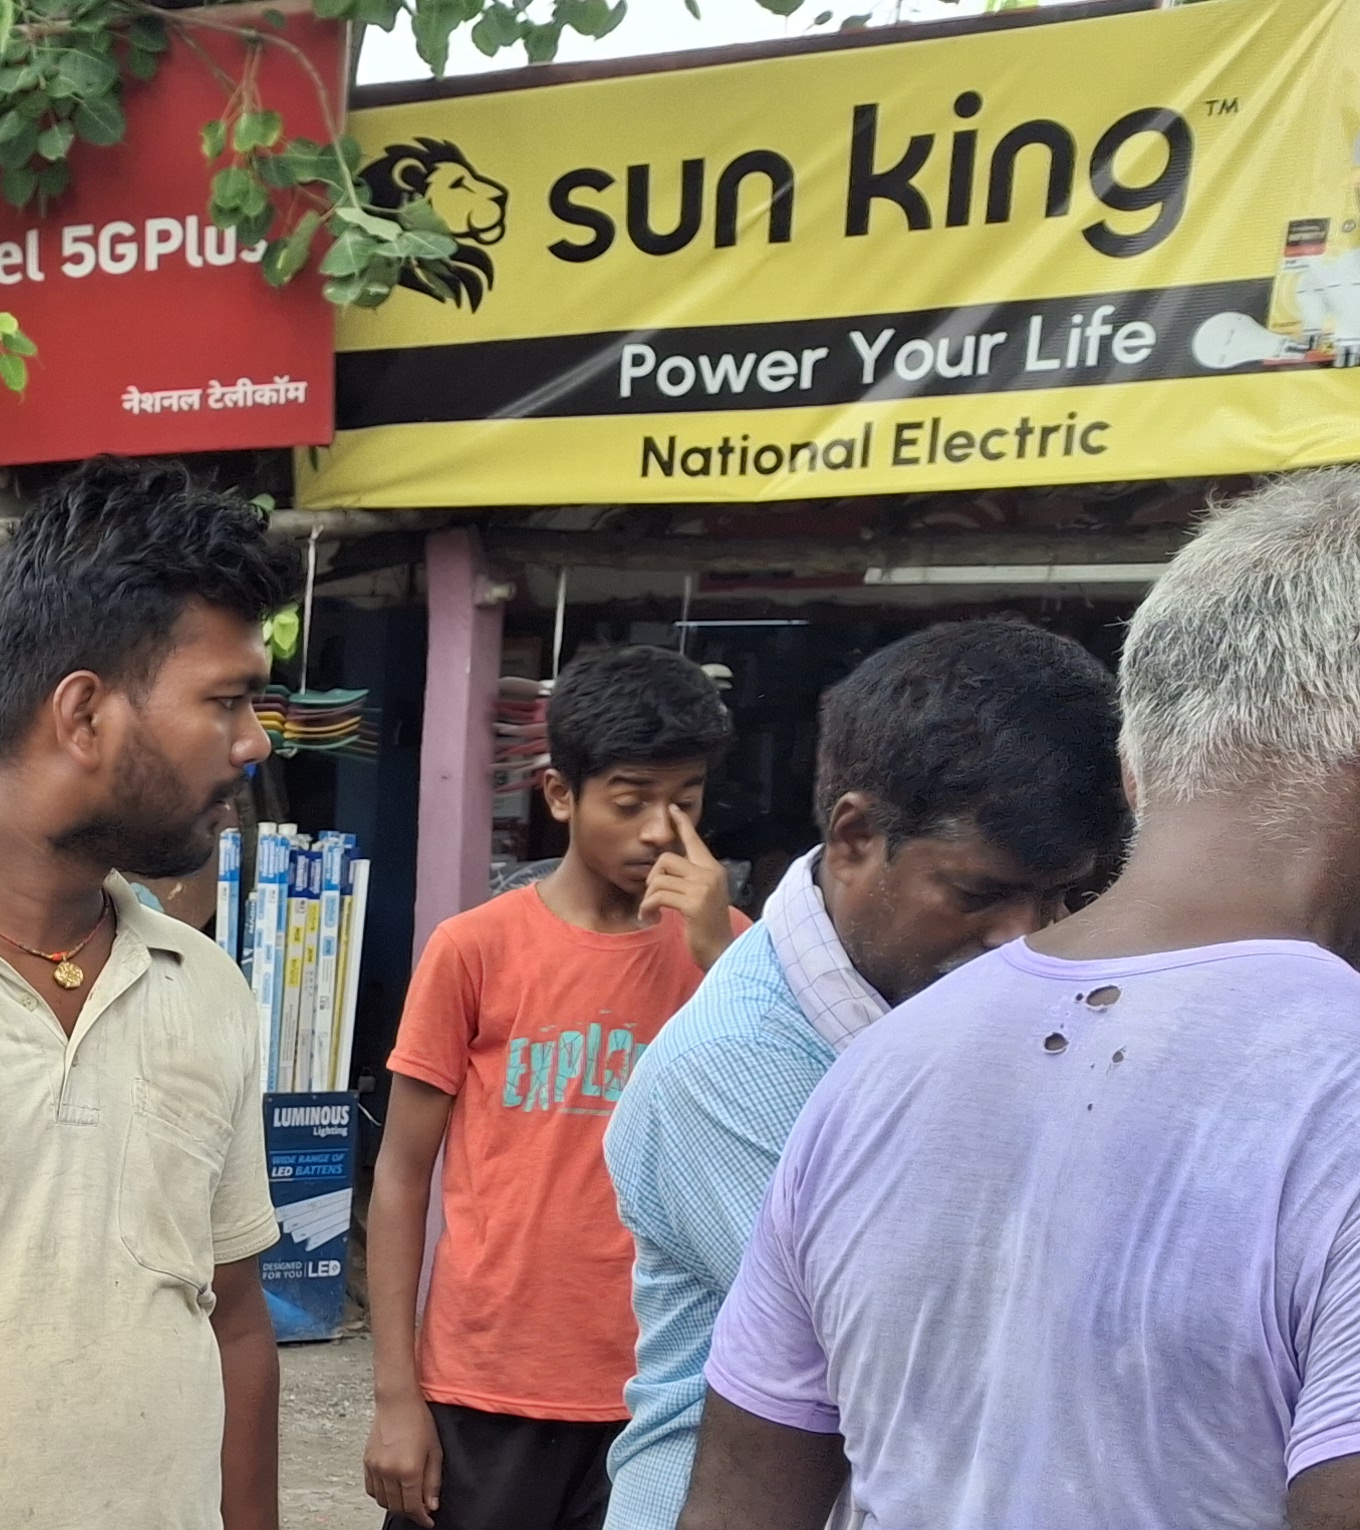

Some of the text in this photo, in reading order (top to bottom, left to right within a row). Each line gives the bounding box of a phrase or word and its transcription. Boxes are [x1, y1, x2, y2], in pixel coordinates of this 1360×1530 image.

[547, 149, 795, 263] sun
[845, 90, 1194, 259] king
[618, 305, 1158, 398] Power Your Life
[121, 375, 308, 414] नेशनल टेलीकॉम
[640, 412, 1113, 480] National Electric
[502, 1022, 649, 1113] EXPLO
[272, 1104, 350, 1128] LUMINOUS
[312, 1126, 349, 1138] Lighting
[272, 1152, 346, 1165] WIDE RANGE OF
[271, 1164, 344, 1178] LED BATTENS
[262, 1261, 302, 1271] DESIGNED
[262, 1269, 303, 1280] FOR YOU
[307, 1260, 341, 1278] LED
